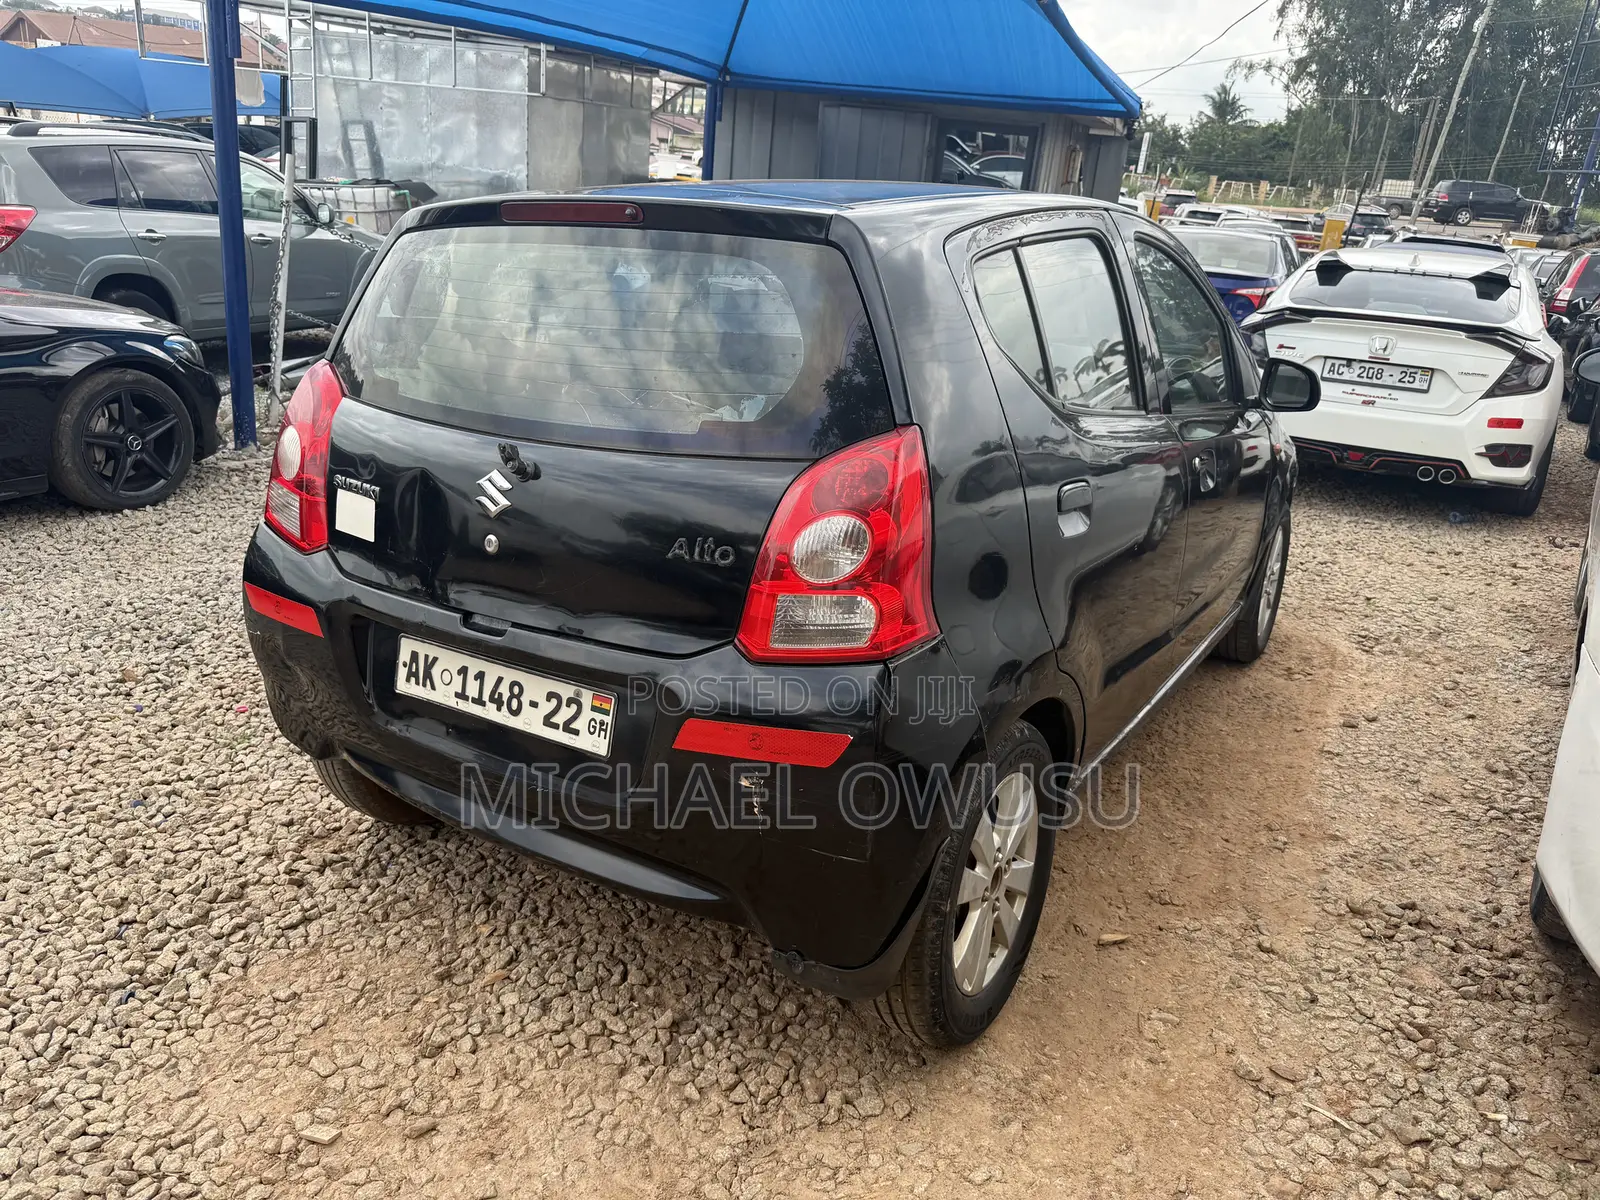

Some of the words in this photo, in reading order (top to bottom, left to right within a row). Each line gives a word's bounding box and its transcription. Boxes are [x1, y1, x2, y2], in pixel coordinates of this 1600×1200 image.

[1327, 362, 1345, 376] AC
[1357, 366, 1384, 380] 208
[1398, 370, 1418, 384] 25
[333, 474, 380, 501] SUZUKI
[665, 537, 736, 567] Alto
[405, 650, 439, 691] AK
[587, 717, 609, 740] GH
